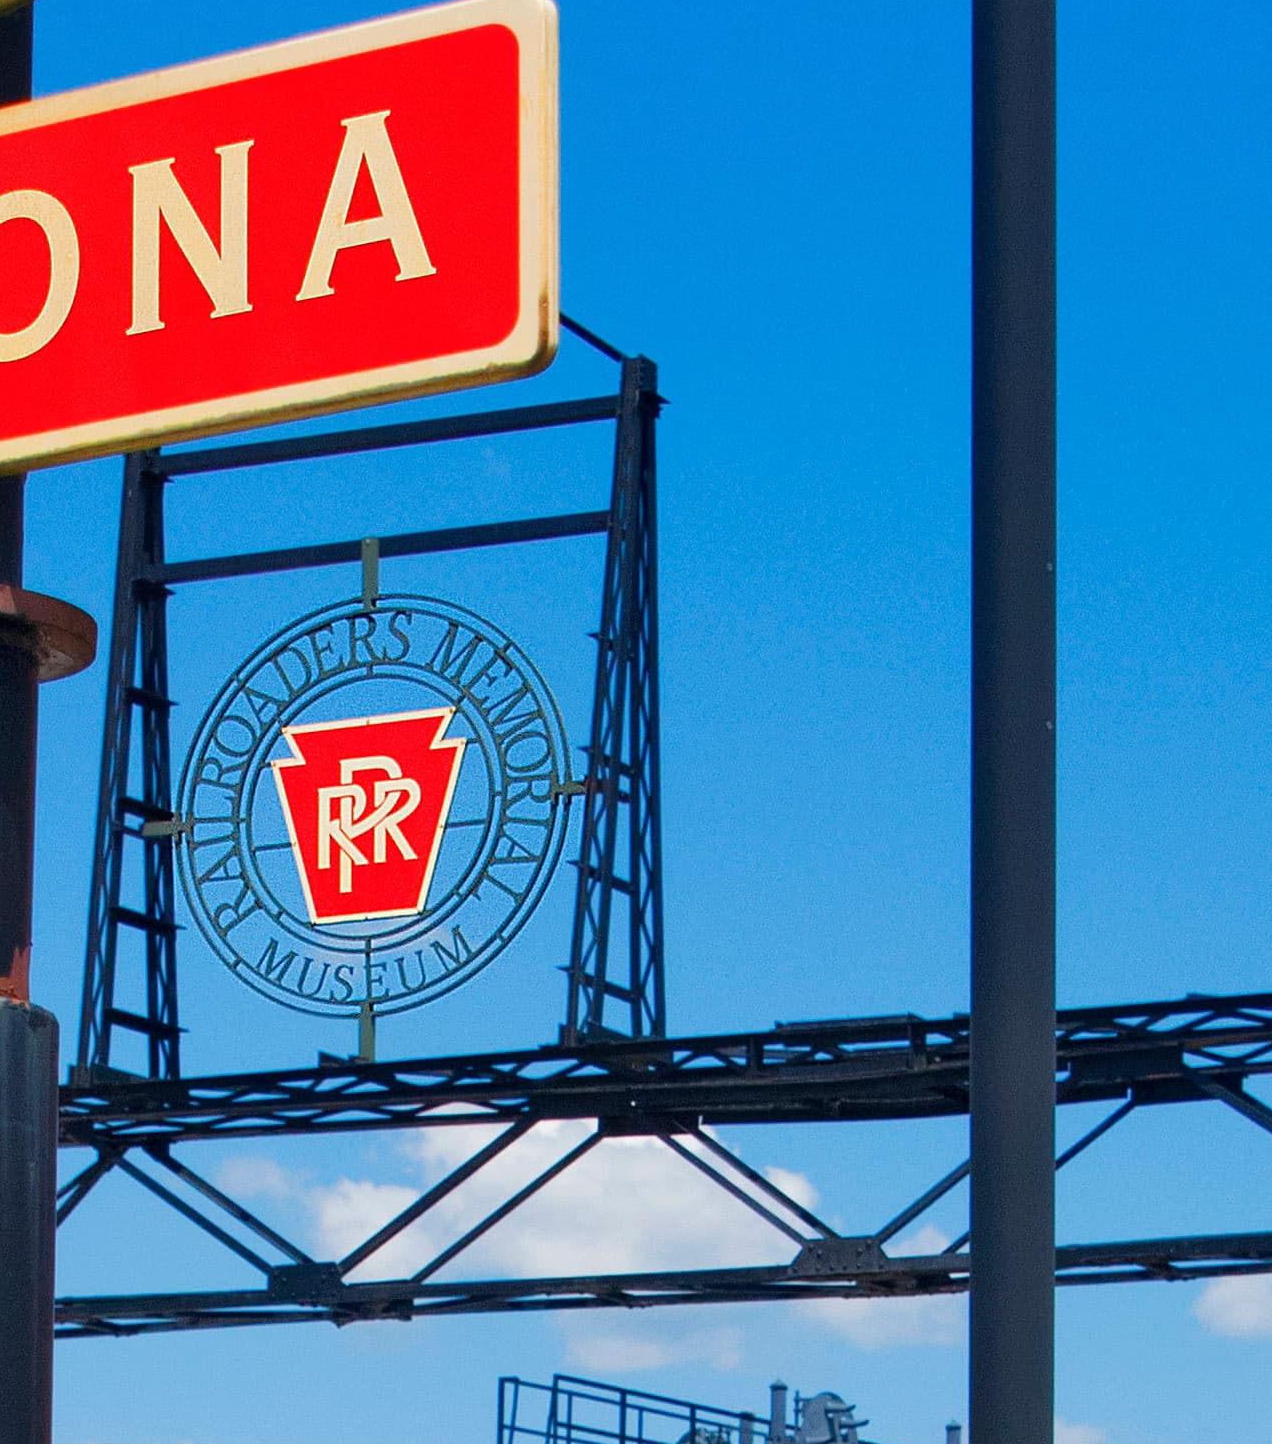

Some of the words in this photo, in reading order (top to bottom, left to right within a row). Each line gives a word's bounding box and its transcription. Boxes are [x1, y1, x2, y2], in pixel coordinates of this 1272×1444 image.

[194, 610, 413, 937] RAILROADERS
[424, 620, 558, 905] MEMORIAL
[255, 924, 475, 1005] MUSEUM
